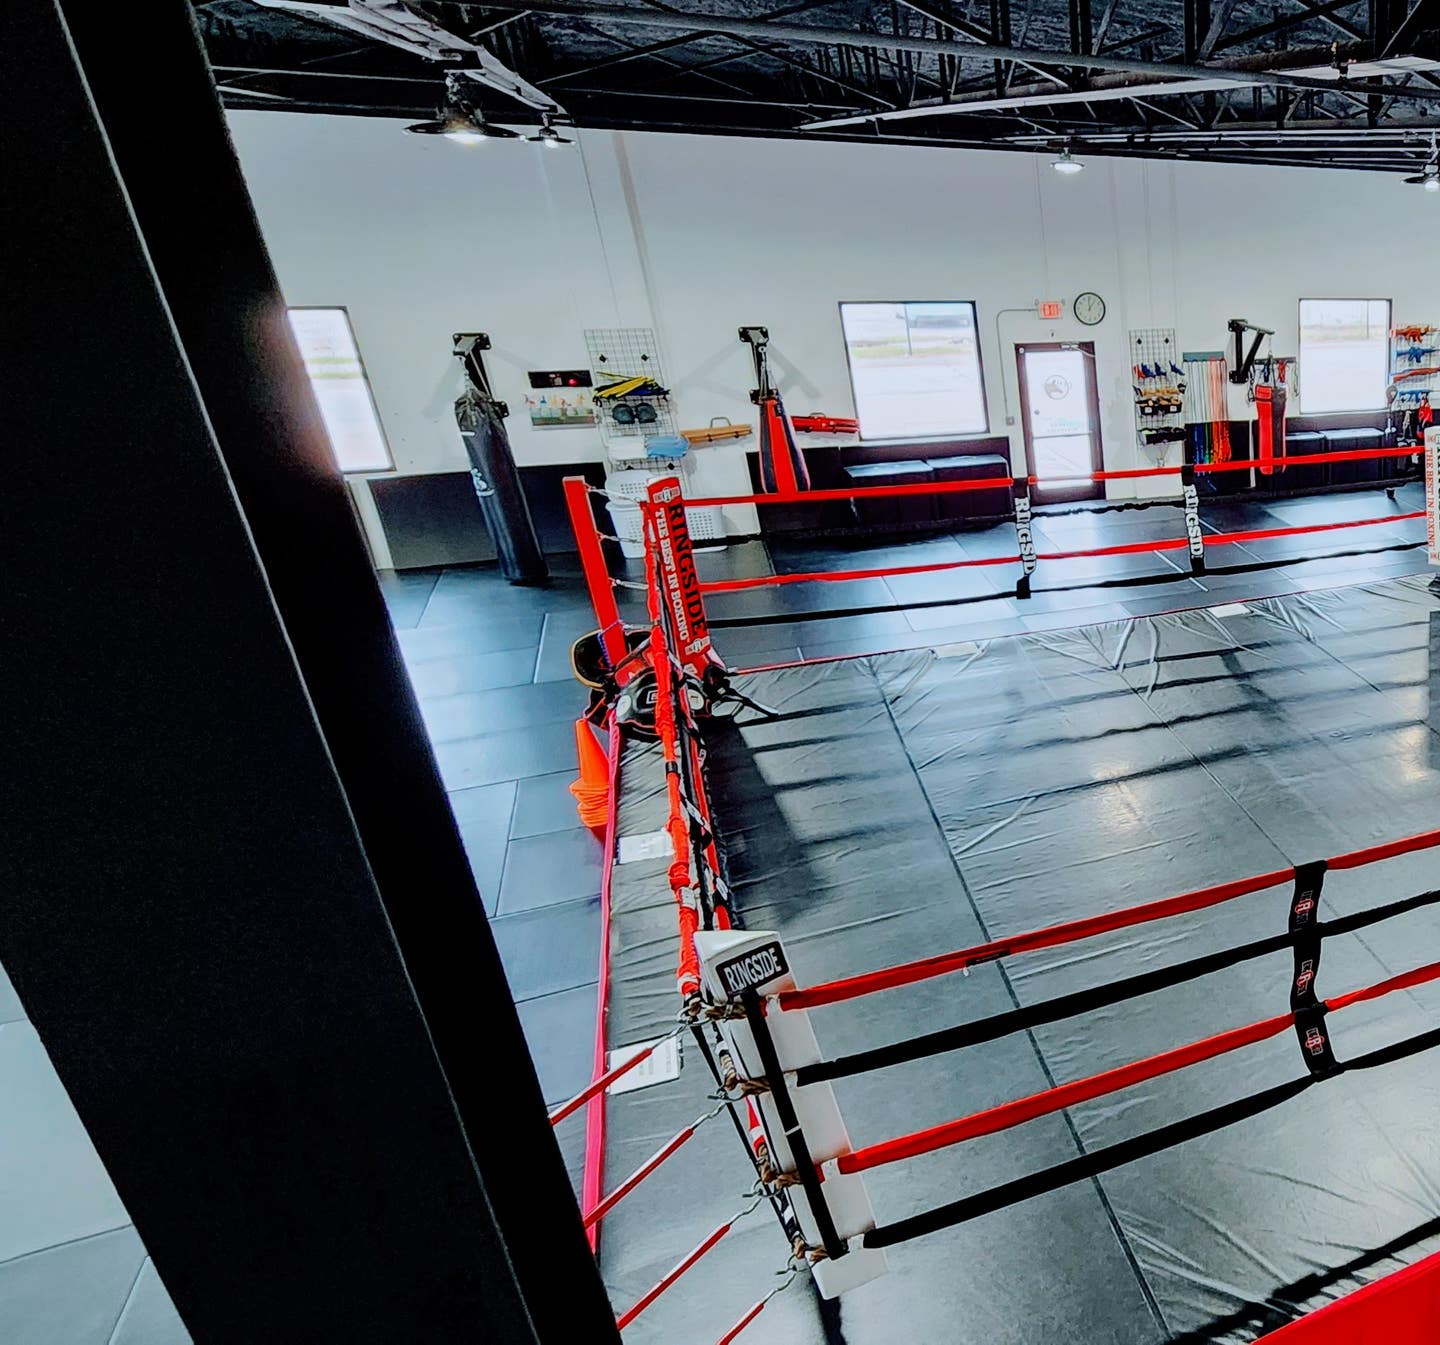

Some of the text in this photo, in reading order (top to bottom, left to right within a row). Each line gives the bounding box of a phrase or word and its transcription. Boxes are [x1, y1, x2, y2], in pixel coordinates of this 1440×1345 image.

[1426, 471, 1434, 495] BEST
[1427, 497, 1434, 508] IN
[655, 507, 669, 538] THE
[1427, 512, 1435, 547] BOXING
[660, 537, 677, 575] BEST
[668, 502, 707, 637] RINGSIDE
[667, 573, 679, 590] IN
[671, 591, 689, 641] BOXING
[723, 947, 782, 992] RINGSIDE
